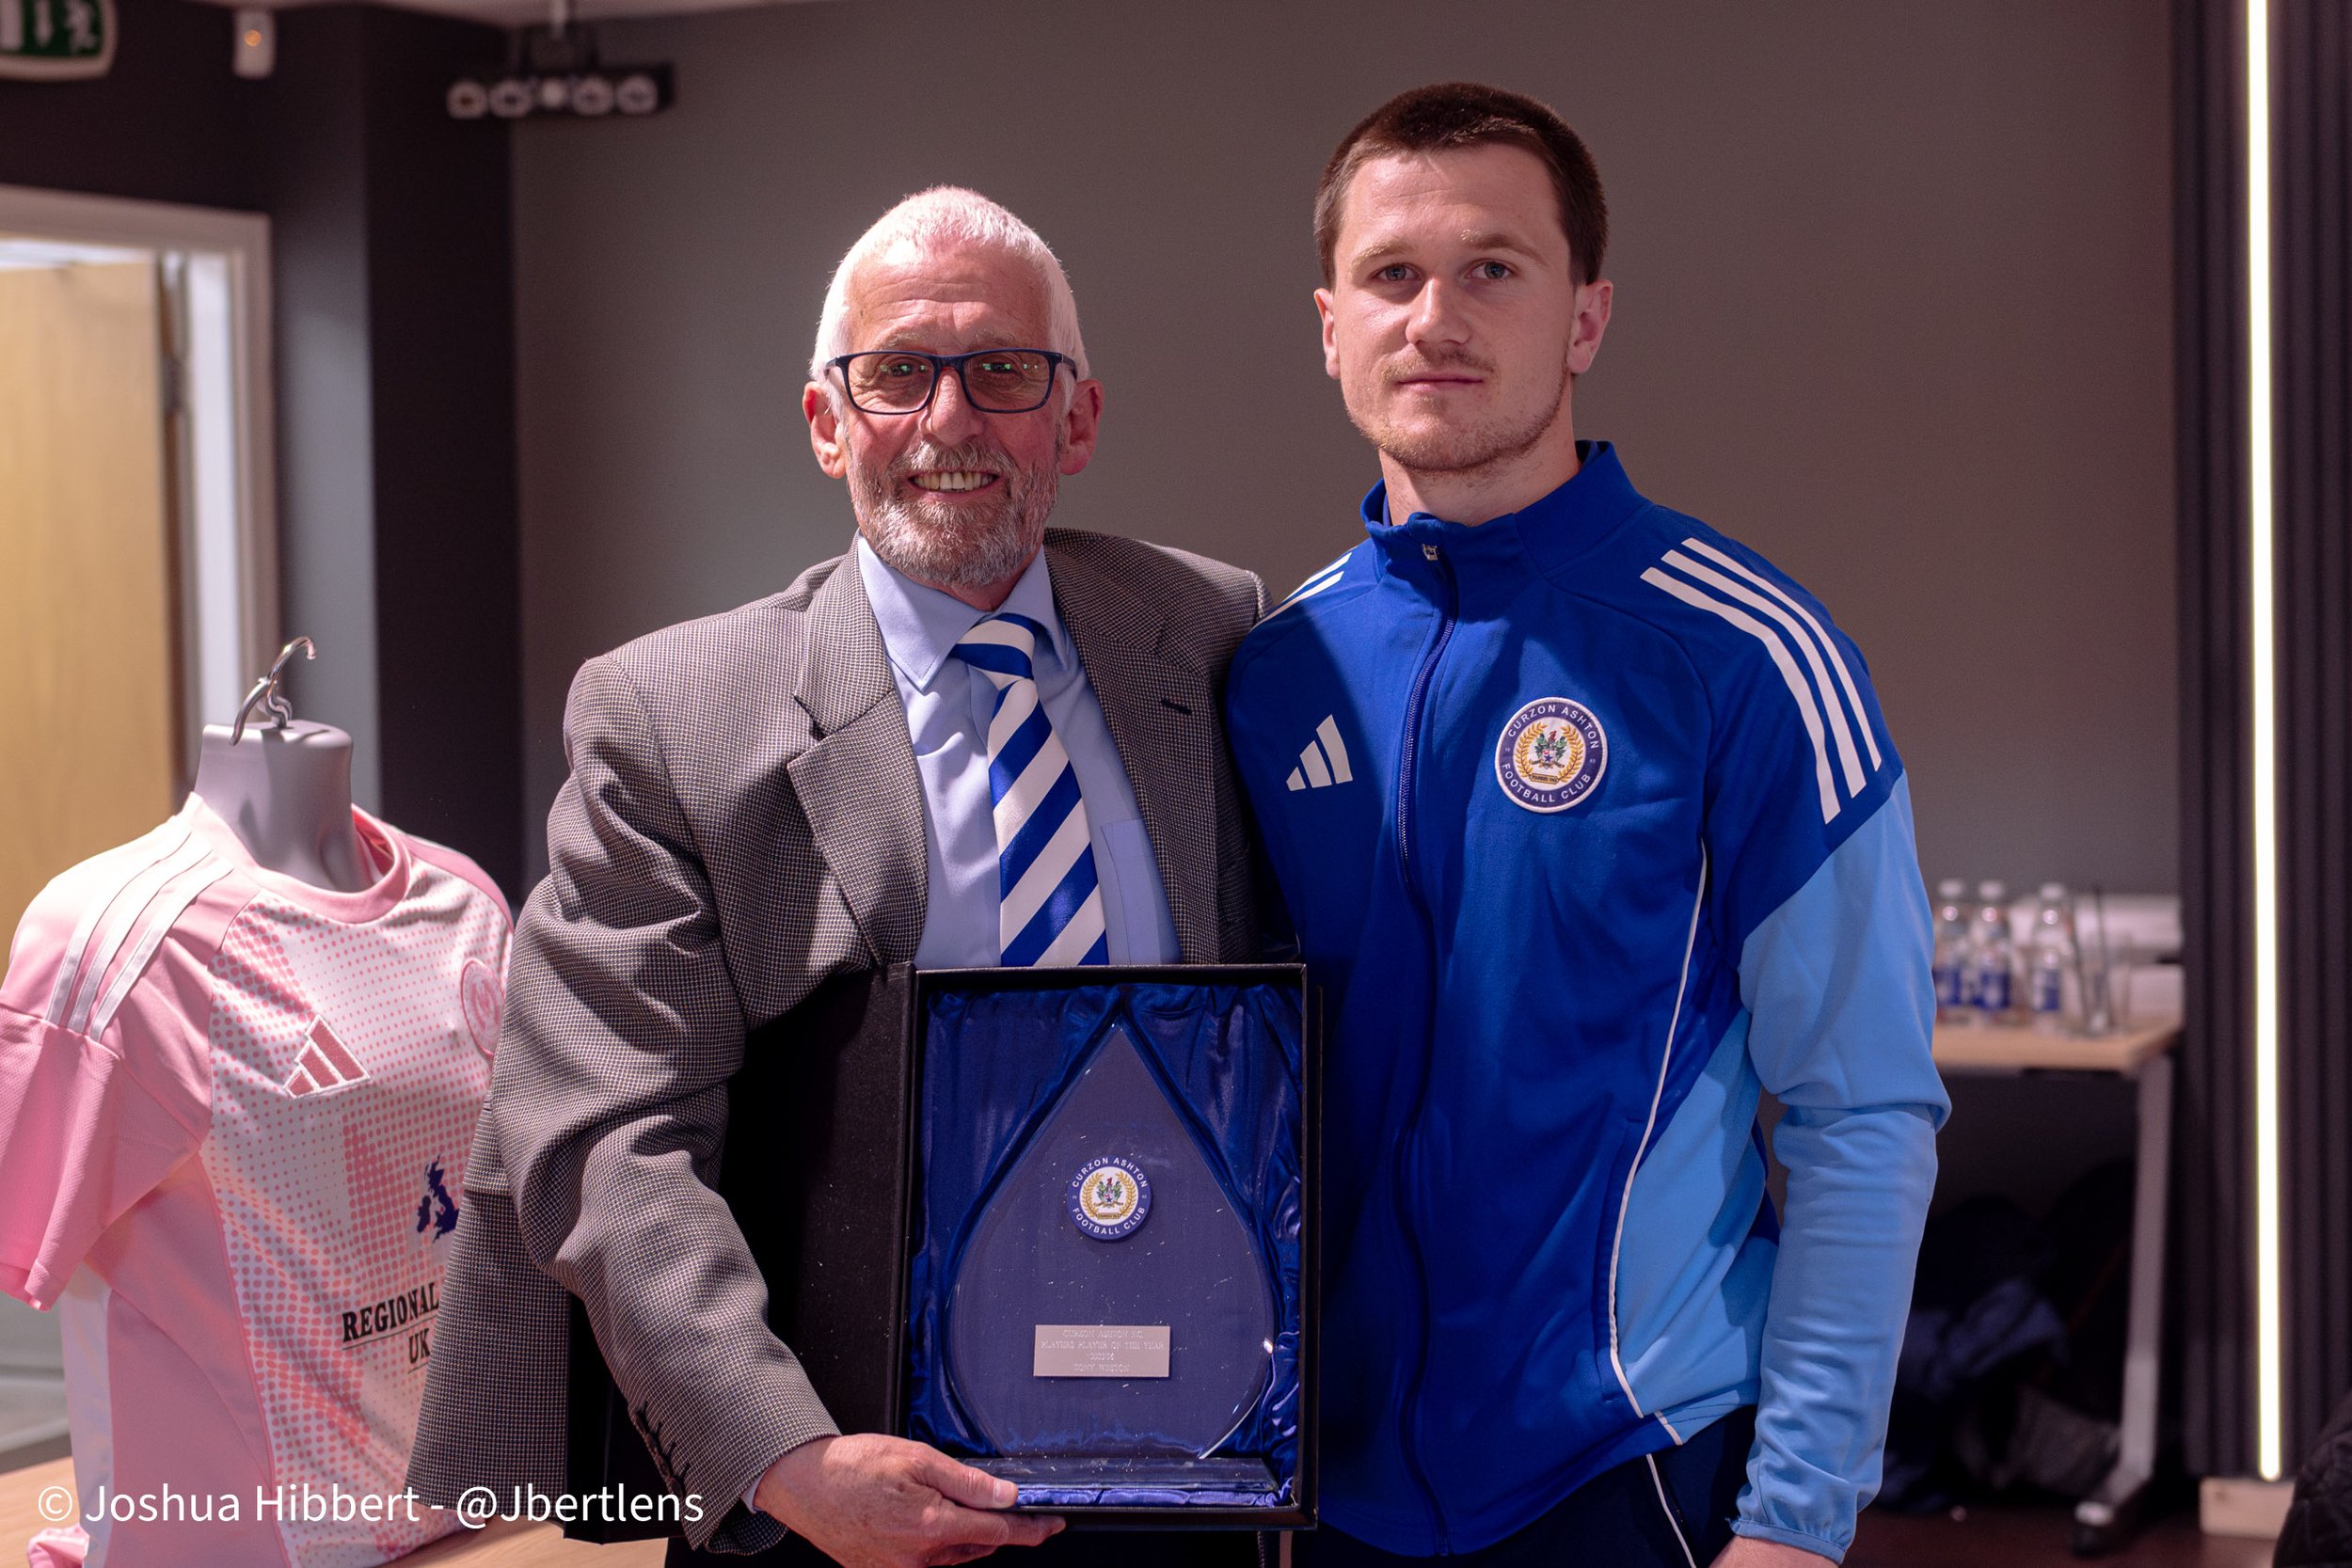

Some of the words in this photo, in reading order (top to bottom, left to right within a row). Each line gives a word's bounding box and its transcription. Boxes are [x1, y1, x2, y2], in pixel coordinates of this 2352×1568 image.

[1508, 705, 1556, 737] CURZON
[1561, 706, 1599, 749] ASHTON
[1502, 763, 1556, 802] FOOTBALL
[1561, 774, 1591, 800] CLUB
[1073, 1157, 1108, 1187] CURZON
[1113, 1157, 1148, 1187] ASHTON
[1073, 1208, 1120, 1234] FOOTBALL
[1123, 1207, 1145, 1229] CLUB
[342, 1282, 439, 1343] REGIONAL
[408, 1328, 430, 1364] UK
